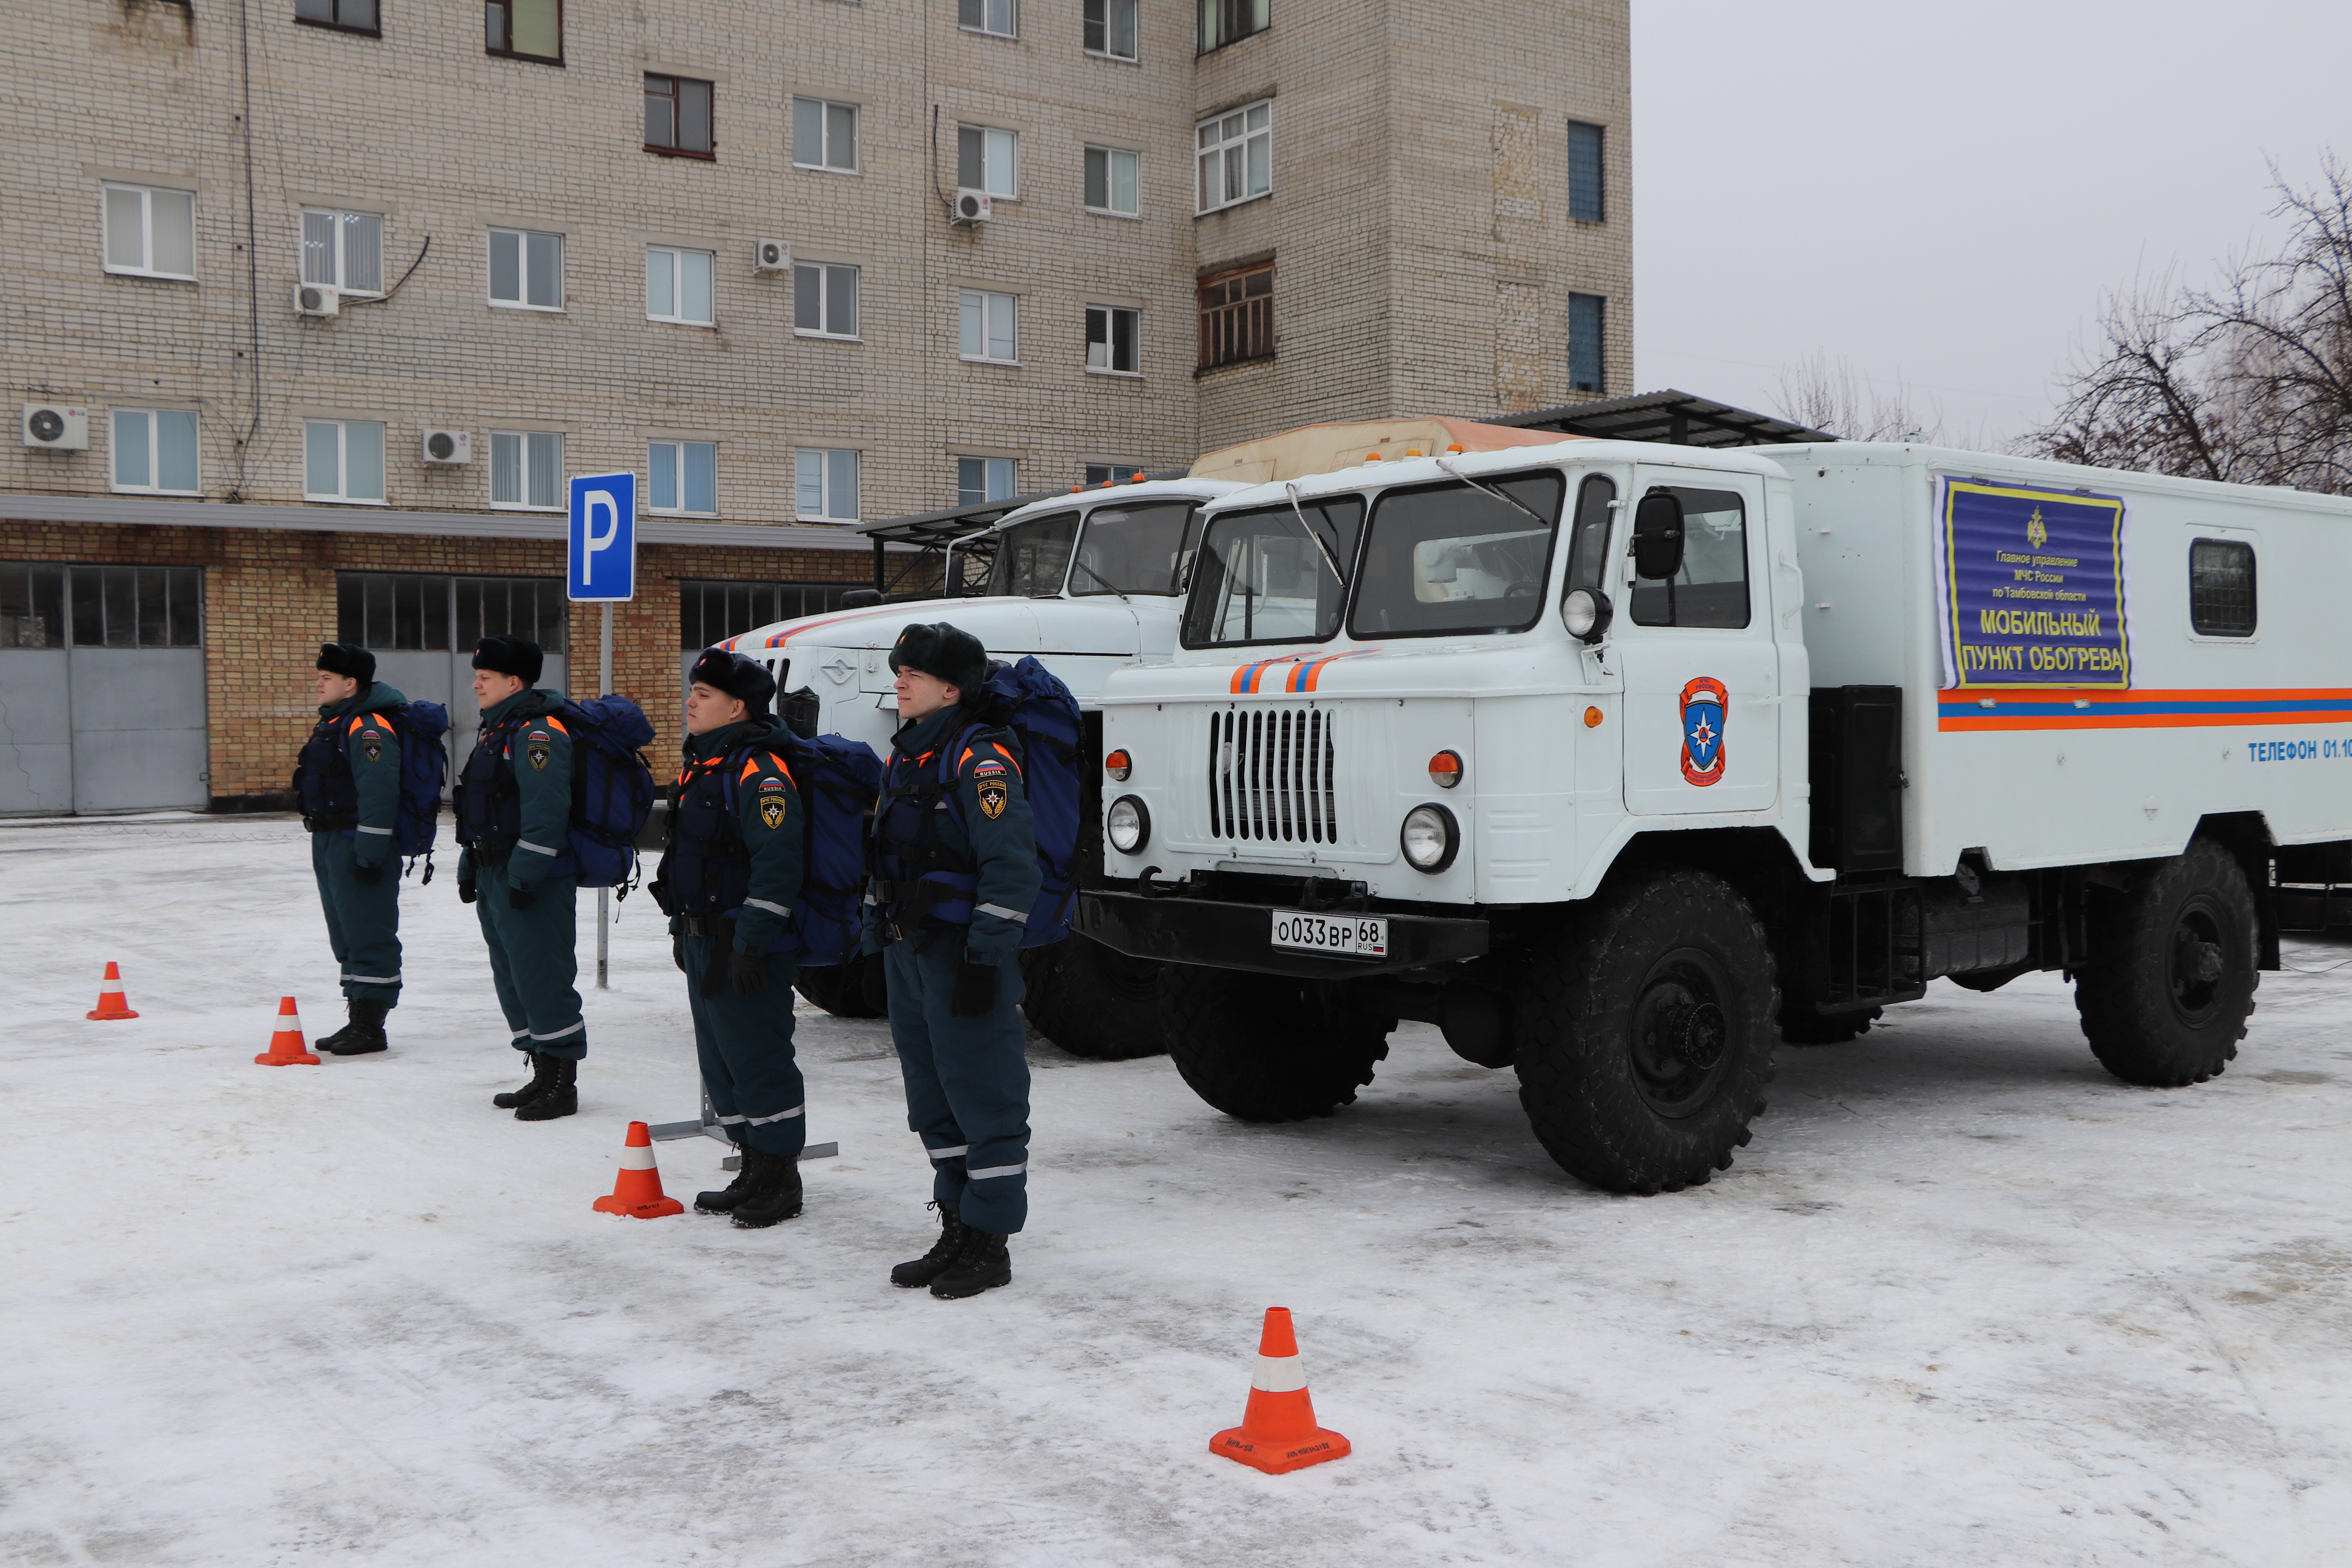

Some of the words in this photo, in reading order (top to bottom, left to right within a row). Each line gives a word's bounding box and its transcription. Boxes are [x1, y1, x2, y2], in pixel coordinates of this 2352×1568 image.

[583, 490, 618, 585] P
[1996, 550, 2031, 564] Главное
[2032, 555, 2078, 567] управление
[2014, 569, 2034, 581] МЧС
[2035, 570, 2064, 583] России
[1993, 588, 2004, 597] по
[2004, 586, 2054, 600] Тамбовской
[2055, 589, 2086, 602] области
[1980, 608, 2102, 636] МОБИЛЬНЫЙ
[1962, 645, 2023, 670] ПУНКТ
[2030, 647, 2124, 671] ОБОГРЕВА
[2248, 740, 2317, 762] ТЕЛЕФОН
[1359, 921, 1379, 943] 68
